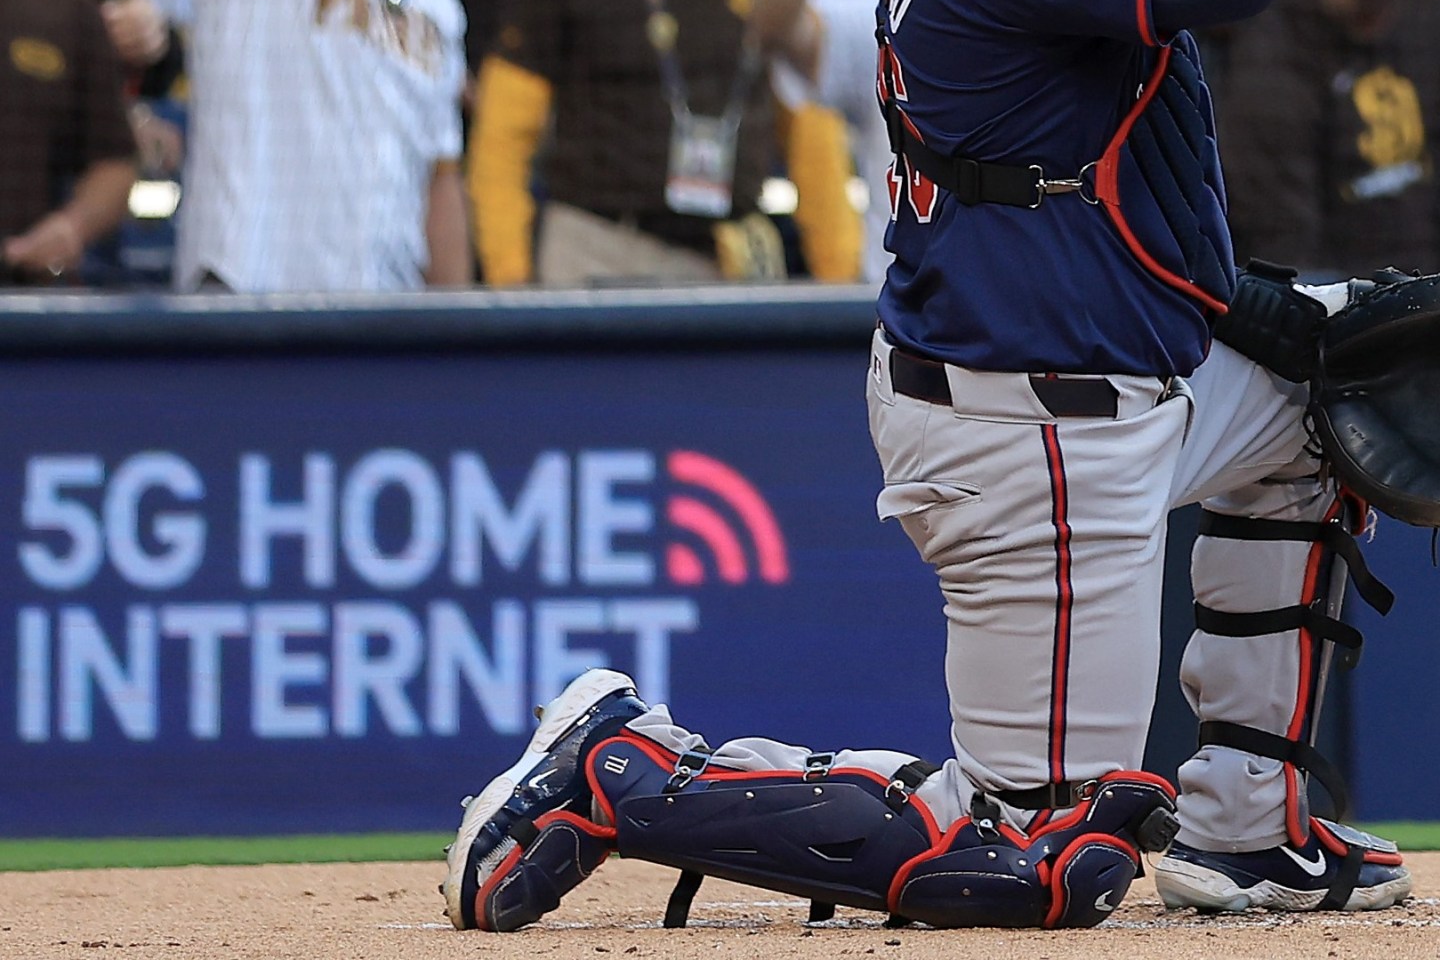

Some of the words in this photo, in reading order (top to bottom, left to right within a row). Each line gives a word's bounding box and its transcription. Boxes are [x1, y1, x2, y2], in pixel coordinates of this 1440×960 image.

[20, 452, 206, 589] 5G
[238, 448, 656, 589] HOME
[16, 598, 697, 742] INTERNET
